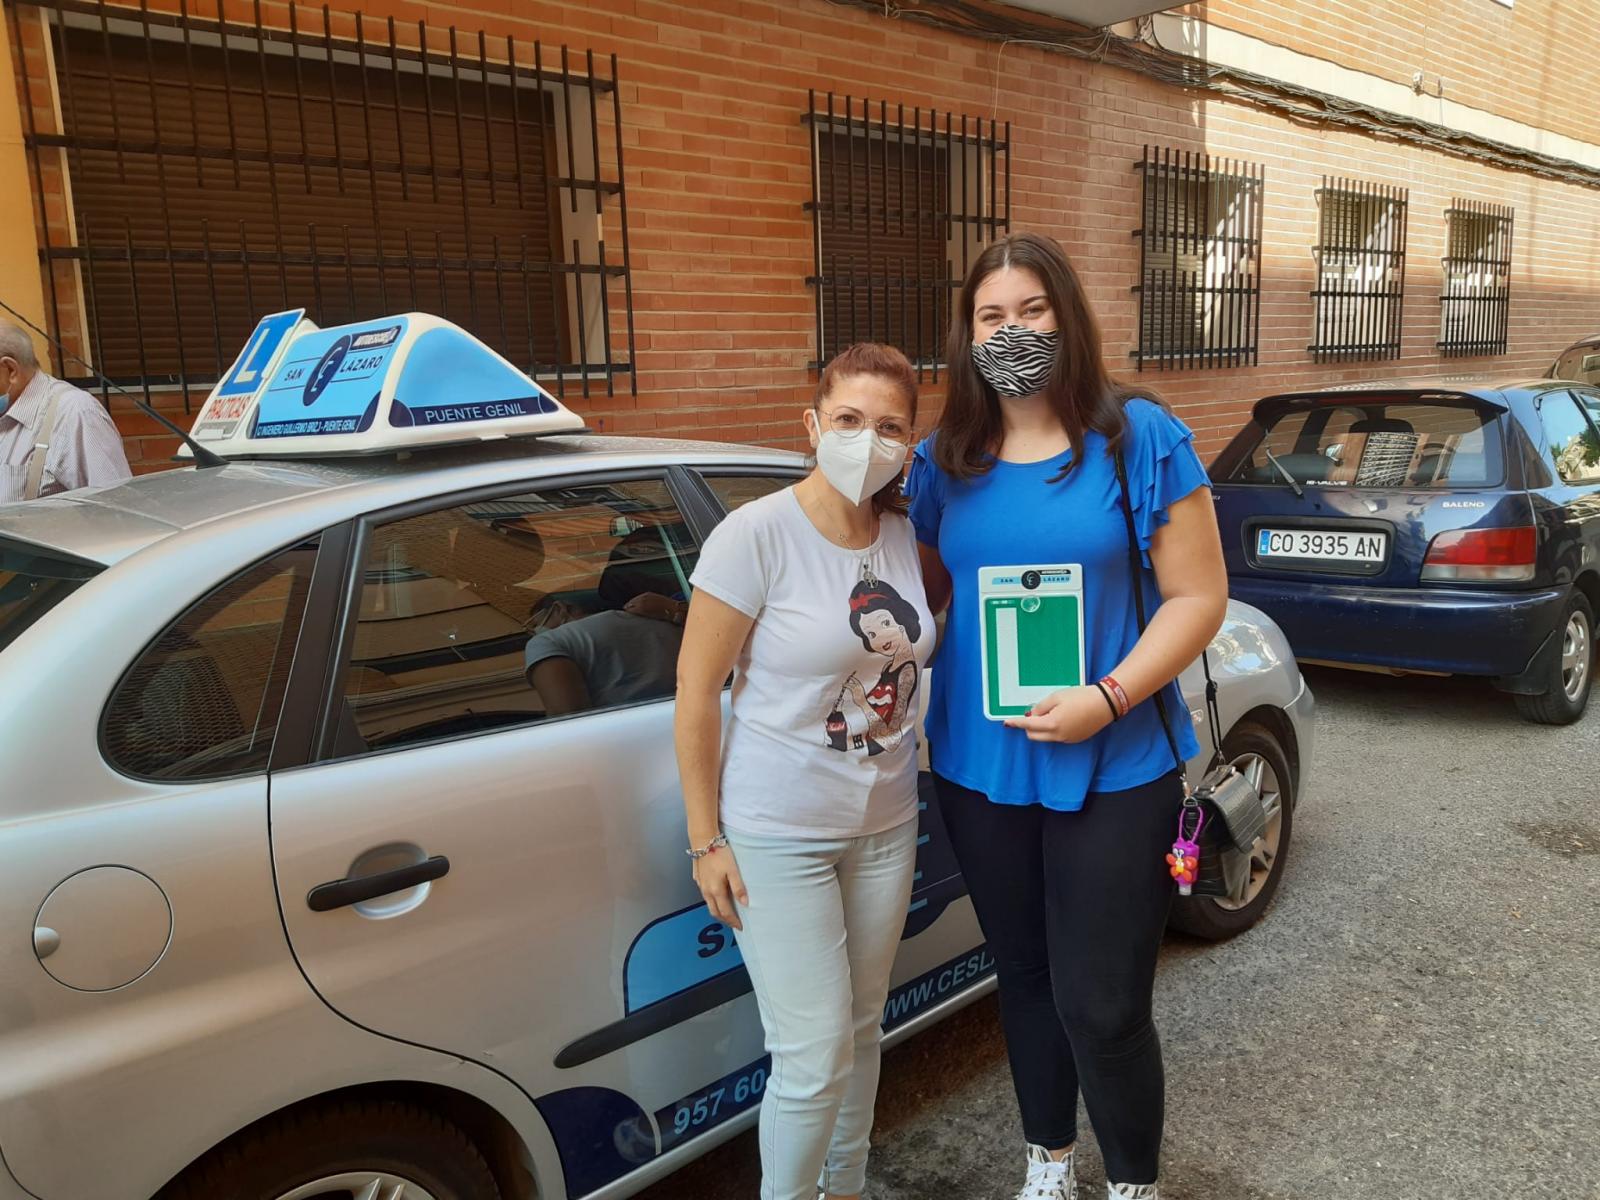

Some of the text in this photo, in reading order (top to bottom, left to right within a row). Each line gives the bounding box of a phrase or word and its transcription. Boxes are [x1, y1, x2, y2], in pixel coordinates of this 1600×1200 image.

[233, 328, 270, 384] L
[284, 368, 305, 381] SAN
[425, 403, 527, 423] PUENTE GENIL
[1442, 500, 1486, 508] BALENO
[1269, 533, 1294, 554] CO
[1300, 533, 1349, 556] 3935
[1354, 537, 1382, 559] AN
[674, 1086, 726, 1135] 957
